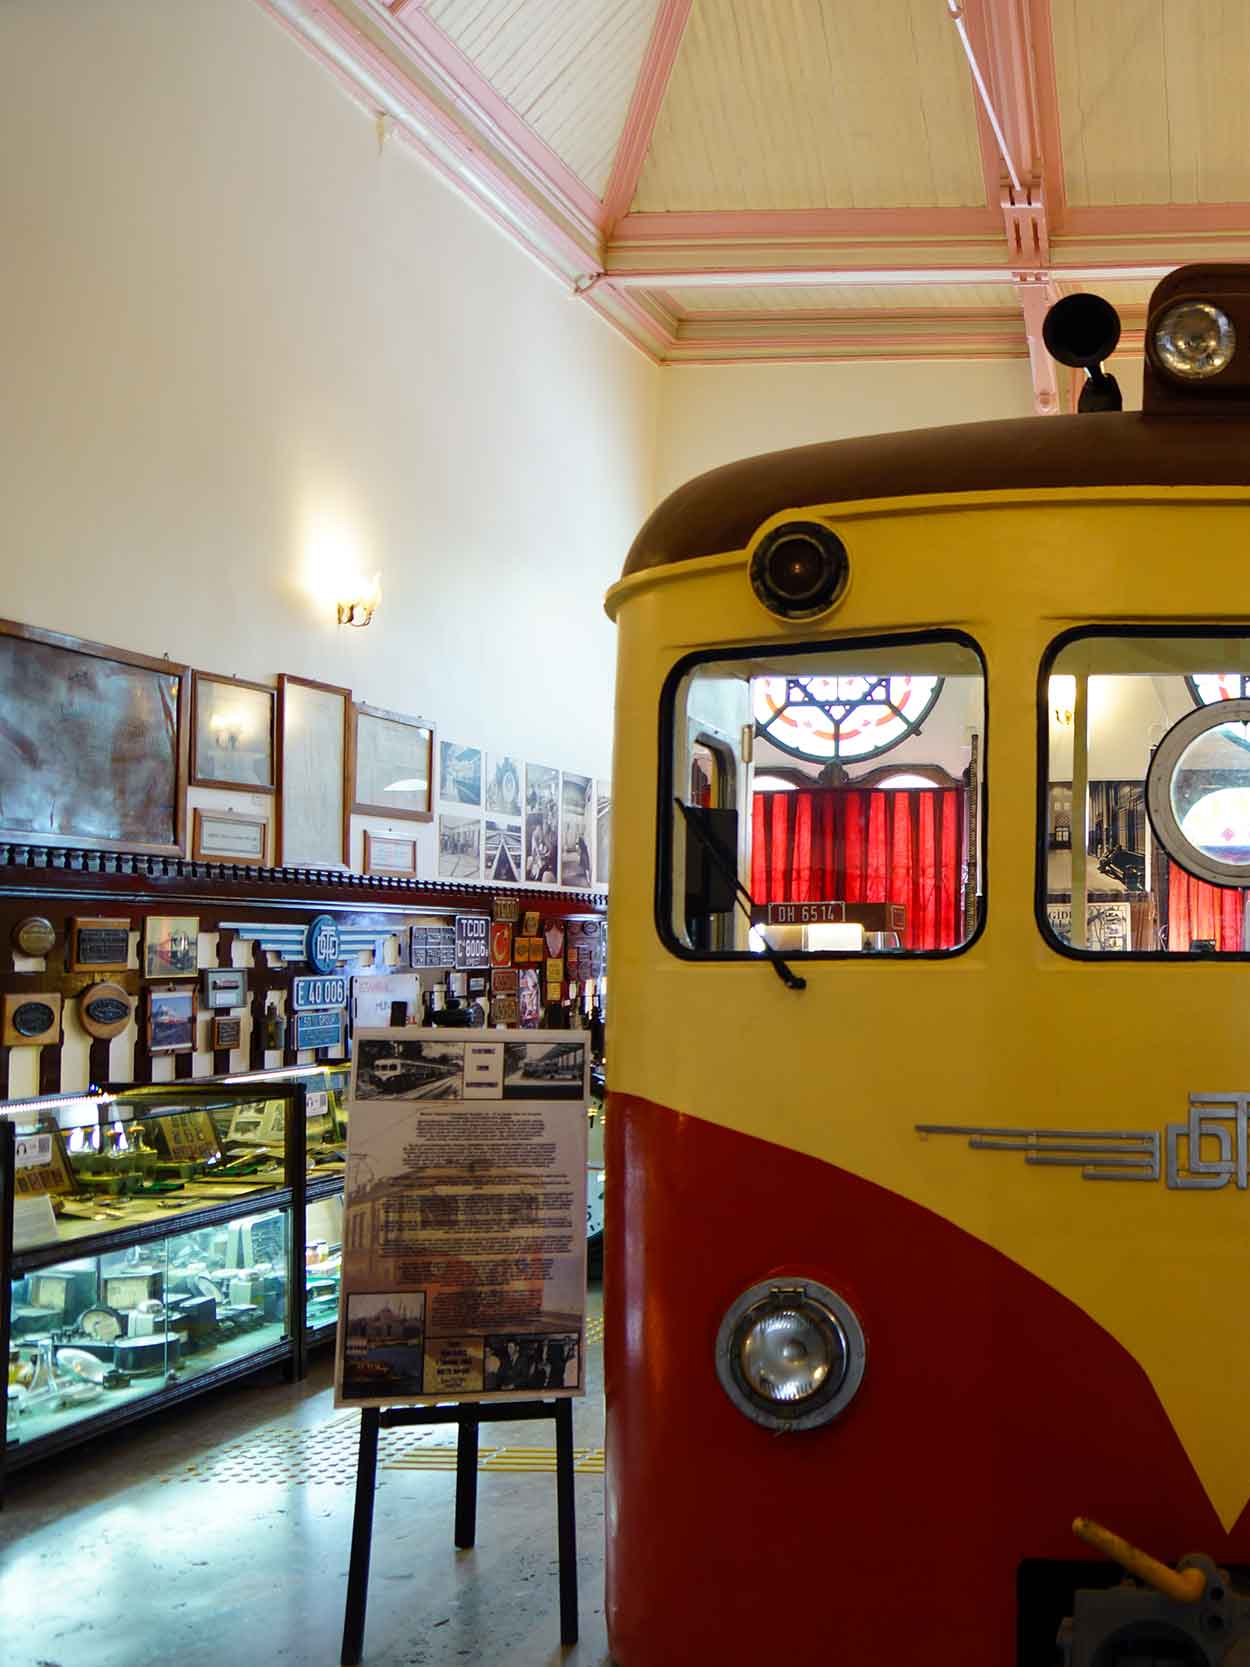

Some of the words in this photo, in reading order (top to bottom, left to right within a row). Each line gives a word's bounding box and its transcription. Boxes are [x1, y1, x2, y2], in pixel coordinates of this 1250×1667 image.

[778, 906, 795, 922] DH
[461, 919, 486, 937] TCDD
[298, 983, 304, 1004] E
[309, 981, 321, 1003] 40
[325, 980, 343, 1002] 006
